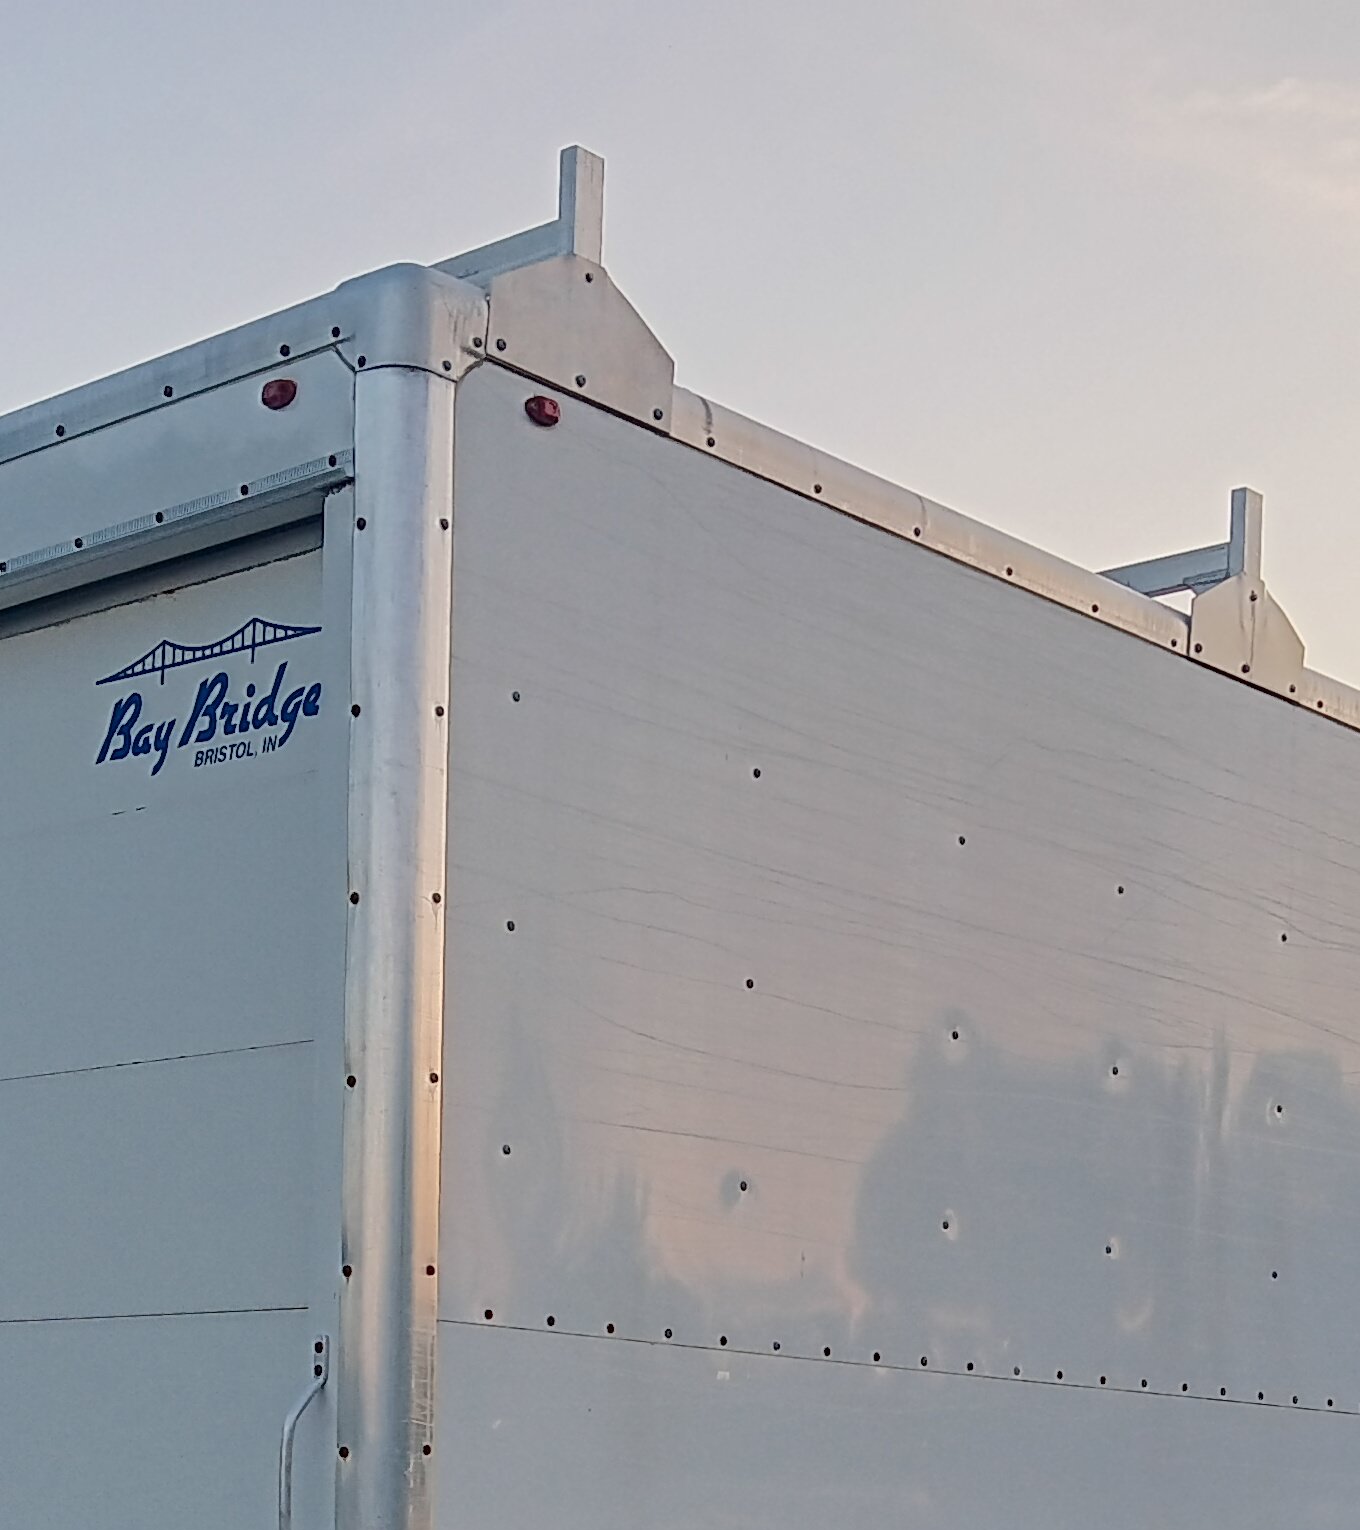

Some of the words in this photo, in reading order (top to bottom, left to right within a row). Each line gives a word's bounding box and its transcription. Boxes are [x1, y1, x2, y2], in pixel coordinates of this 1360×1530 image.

[95, 692, 177, 777] Bay
[178, 660, 322, 749] Bridge
[194, 741, 258, 768] BRISTOL,
[262, 735, 278, 754] IN
